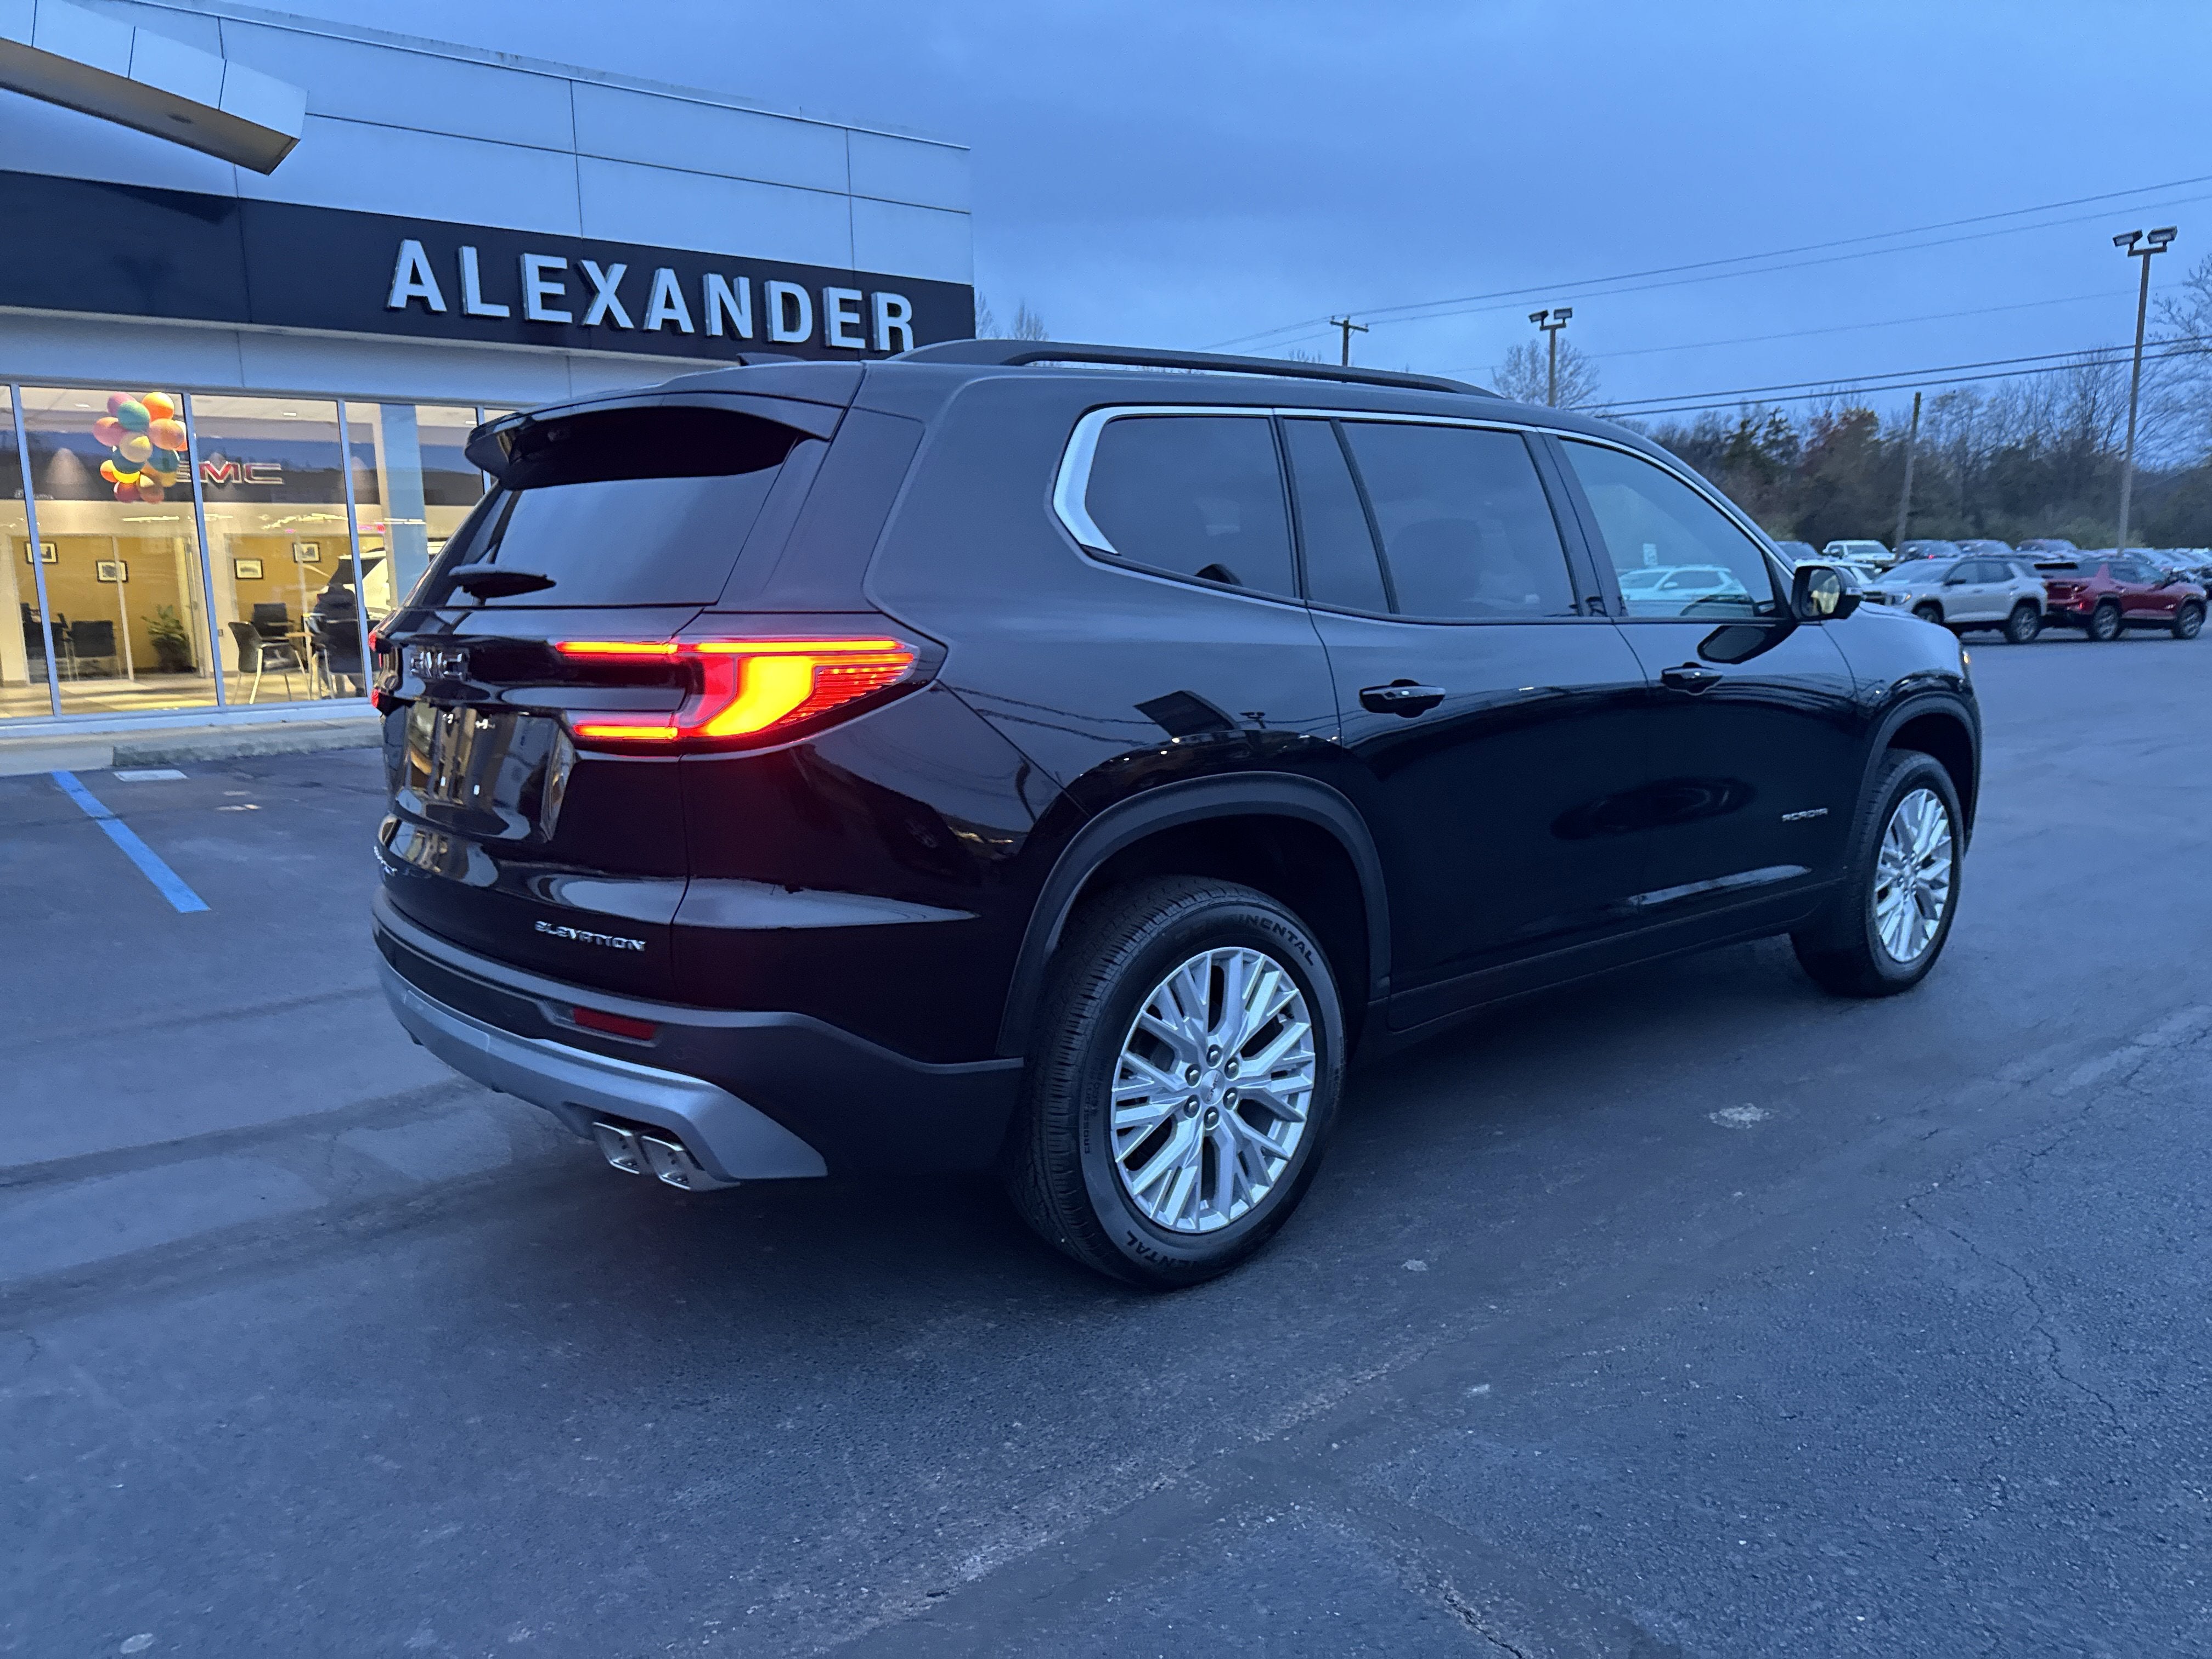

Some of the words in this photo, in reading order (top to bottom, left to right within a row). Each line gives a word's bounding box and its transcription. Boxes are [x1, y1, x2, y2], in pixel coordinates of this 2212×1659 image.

[386, 239, 915, 352] ALEXANDER
[534, 920, 647, 952] ELEVATION
[1207, 1073, 1219, 1102] GMC
